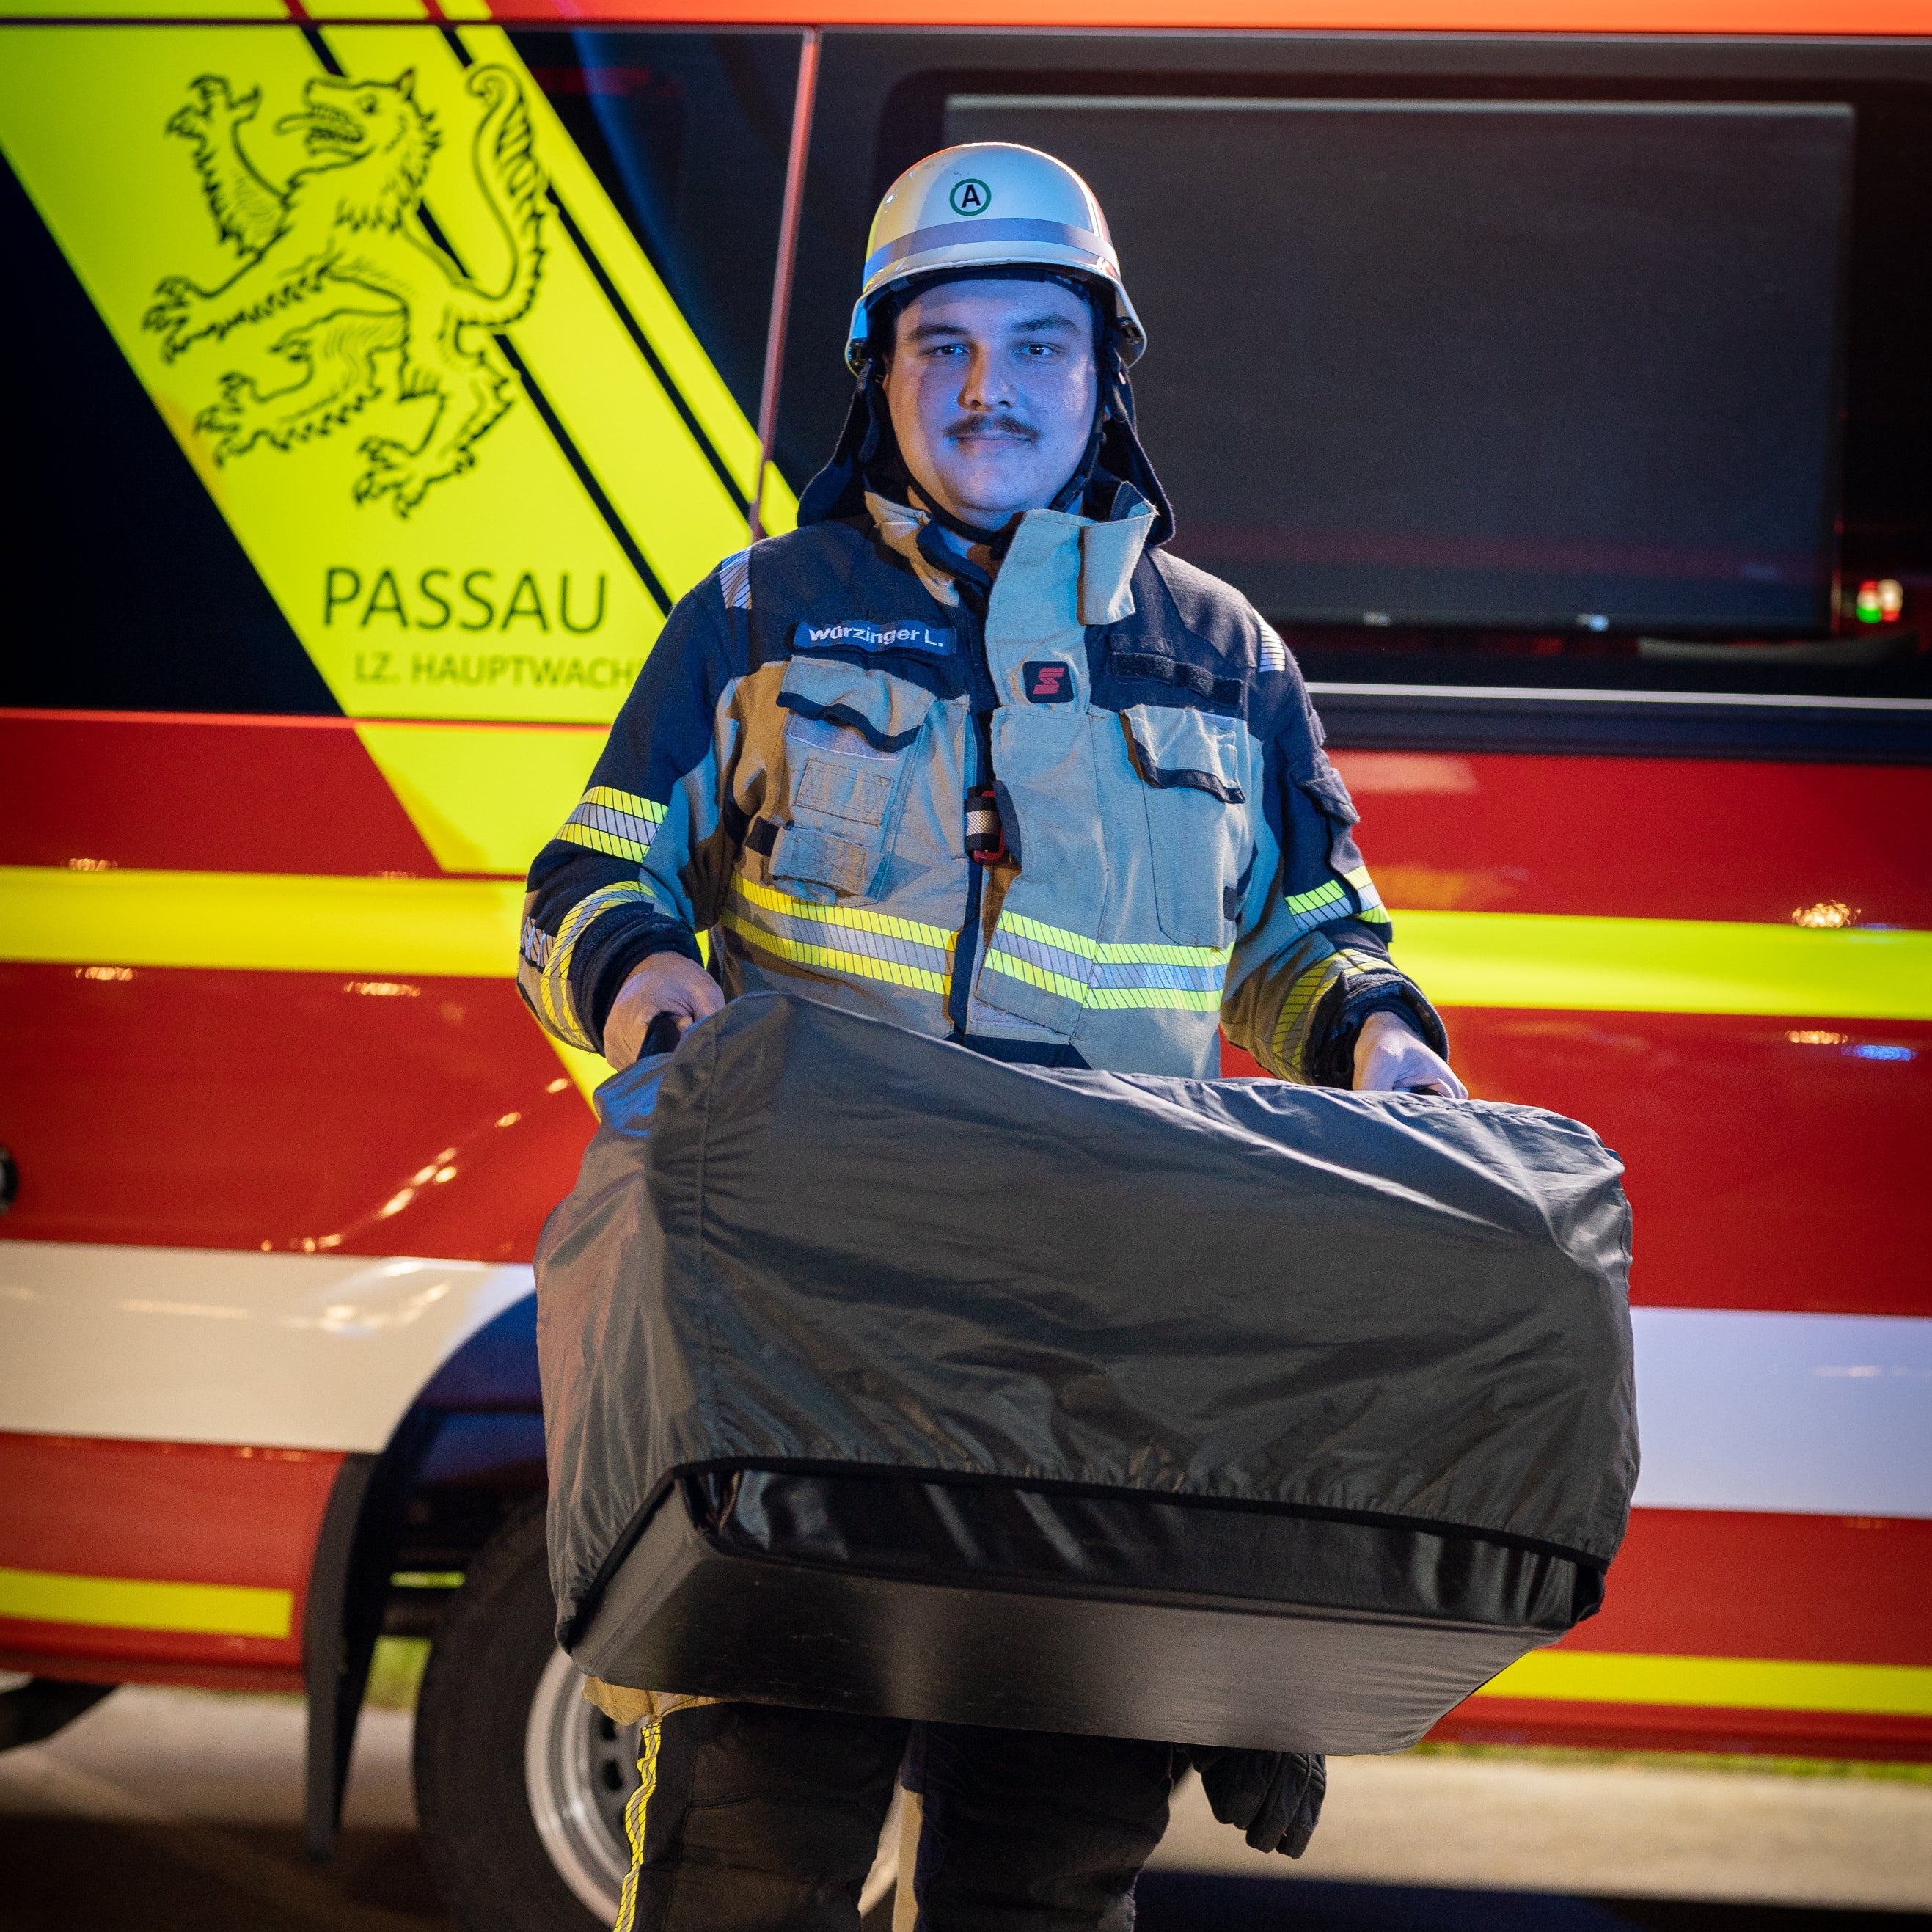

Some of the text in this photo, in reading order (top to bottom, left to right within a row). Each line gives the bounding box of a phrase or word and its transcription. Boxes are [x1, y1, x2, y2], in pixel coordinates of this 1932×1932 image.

[961, 183, 982, 208] A
[323, 566, 608, 634] PASSAU
[924, 629, 943, 648] L.
[355, 651, 645, 691] LZ. HAUPTWACH
